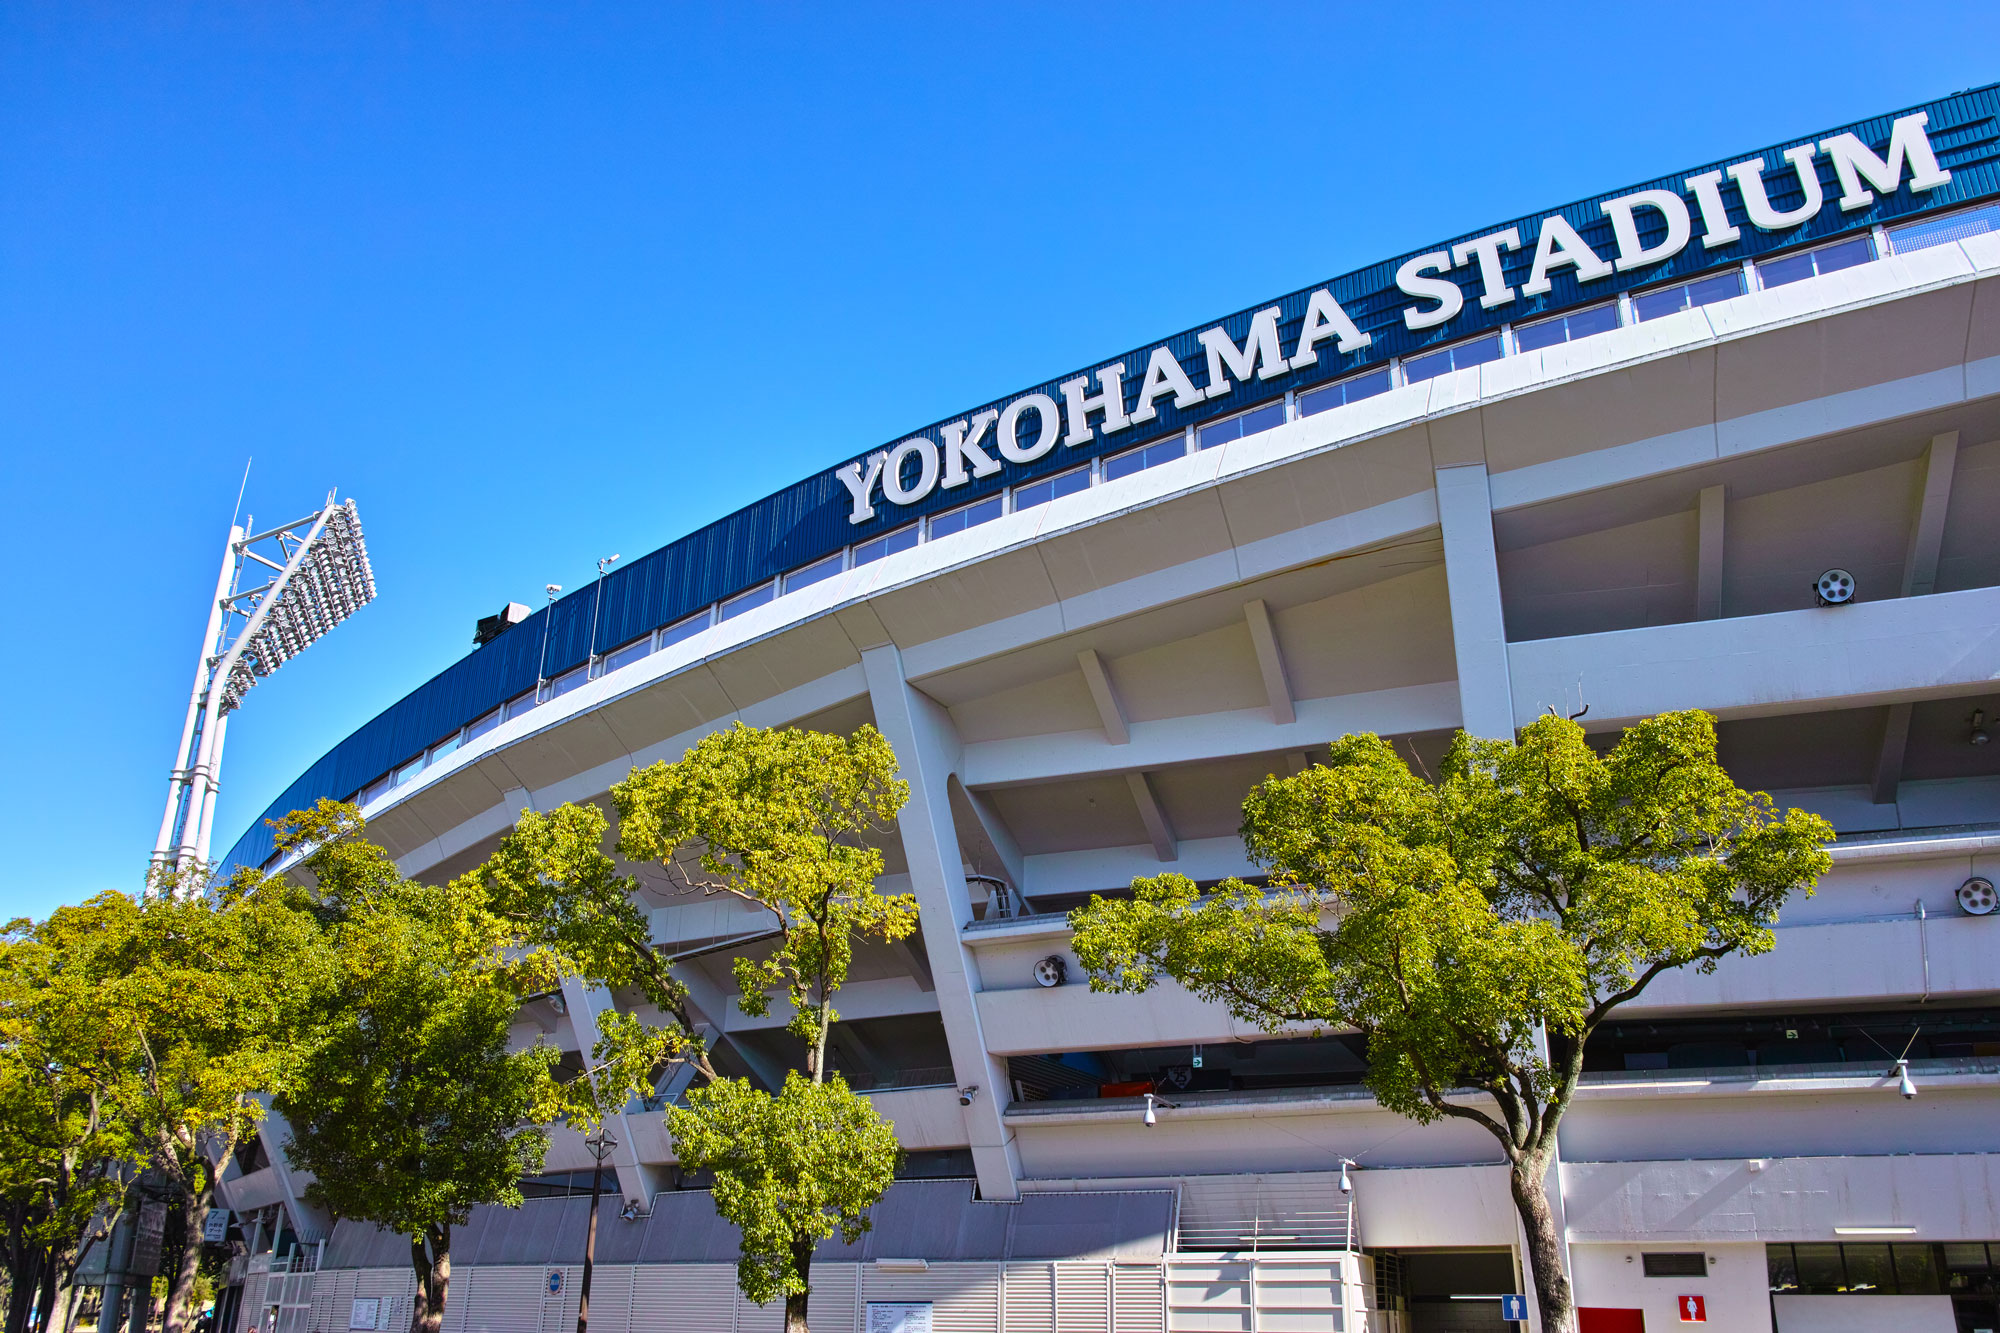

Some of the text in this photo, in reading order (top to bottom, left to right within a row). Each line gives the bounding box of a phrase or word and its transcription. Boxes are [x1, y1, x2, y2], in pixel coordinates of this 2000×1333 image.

[836, 111, 1952, 525] YOKOHAMA STADIUM
[211, 1211, 219, 1219] 7
